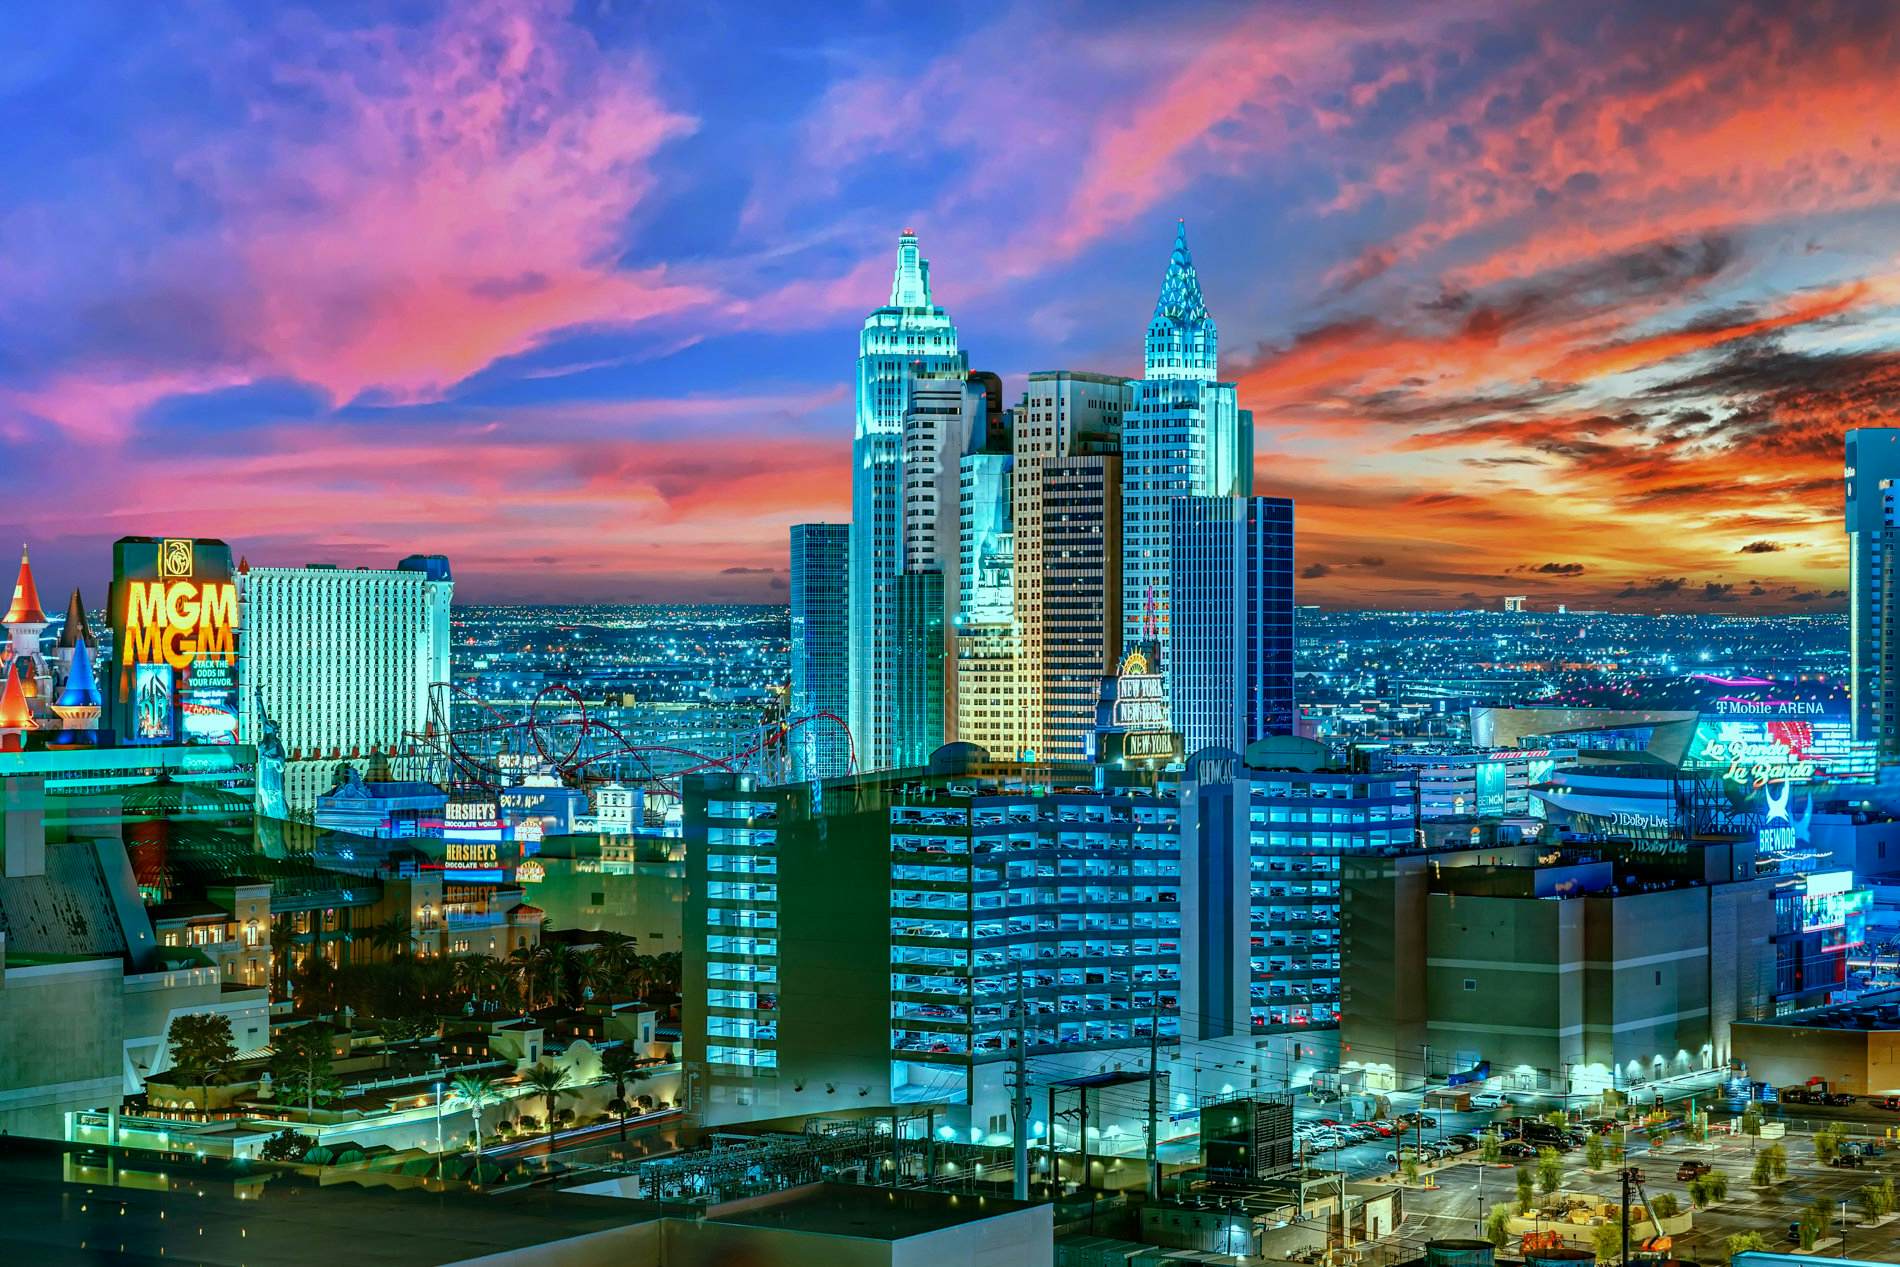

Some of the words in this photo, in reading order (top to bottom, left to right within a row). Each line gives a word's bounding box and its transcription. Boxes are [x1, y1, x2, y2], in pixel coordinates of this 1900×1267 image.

[127, 581, 239, 630] MGM
[122, 622, 235, 668] MGM
[193, 660, 214, 668] STACK
[216, 660, 228, 668] THE
[196, 669, 216, 677] ODDS
[217, 669, 226, 677] IN
[188, 678, 208, 687] YOUR
[209, 678, 234, 687] FAVOR.
[1121, 679, 1140, 698] NEW
[1121, 703, 1141, 722] NEW
[1778, 702, 1825, 714] ARENA
[1130, 735, 1151, 755] NEW
[1723, 760, 1748, 784] La
[445, 803, 496, 820] HERSHEY'S
[1649, 814, 1669, 828] Live
[1759, 827, 1796, 852] BREWDOG
[446, 843, 497, 861] HERSHEY'S
